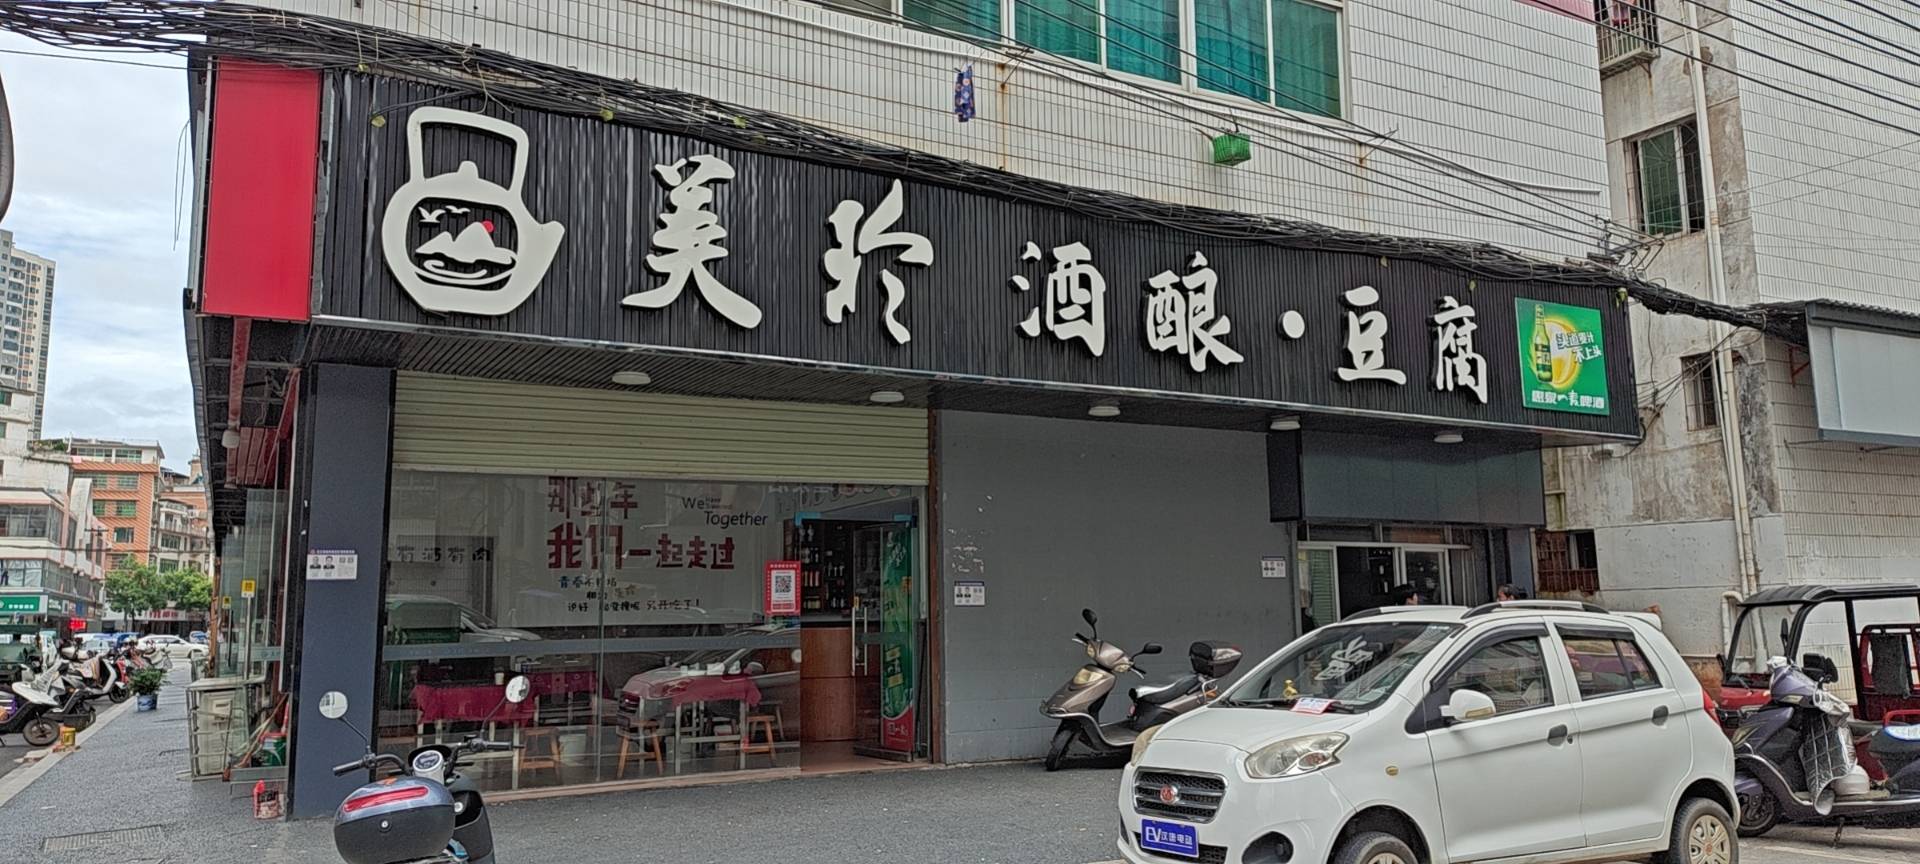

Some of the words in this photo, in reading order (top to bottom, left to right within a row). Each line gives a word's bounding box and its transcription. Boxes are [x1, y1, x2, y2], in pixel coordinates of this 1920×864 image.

[1573, 345, 1602, 363] 不上头
[547, 476, 638, 519] 那些年
[682, 496, 704, 509] We
[704, 511, 768, 529] Together
[547, 522, 735, 569] 我们一起走过
